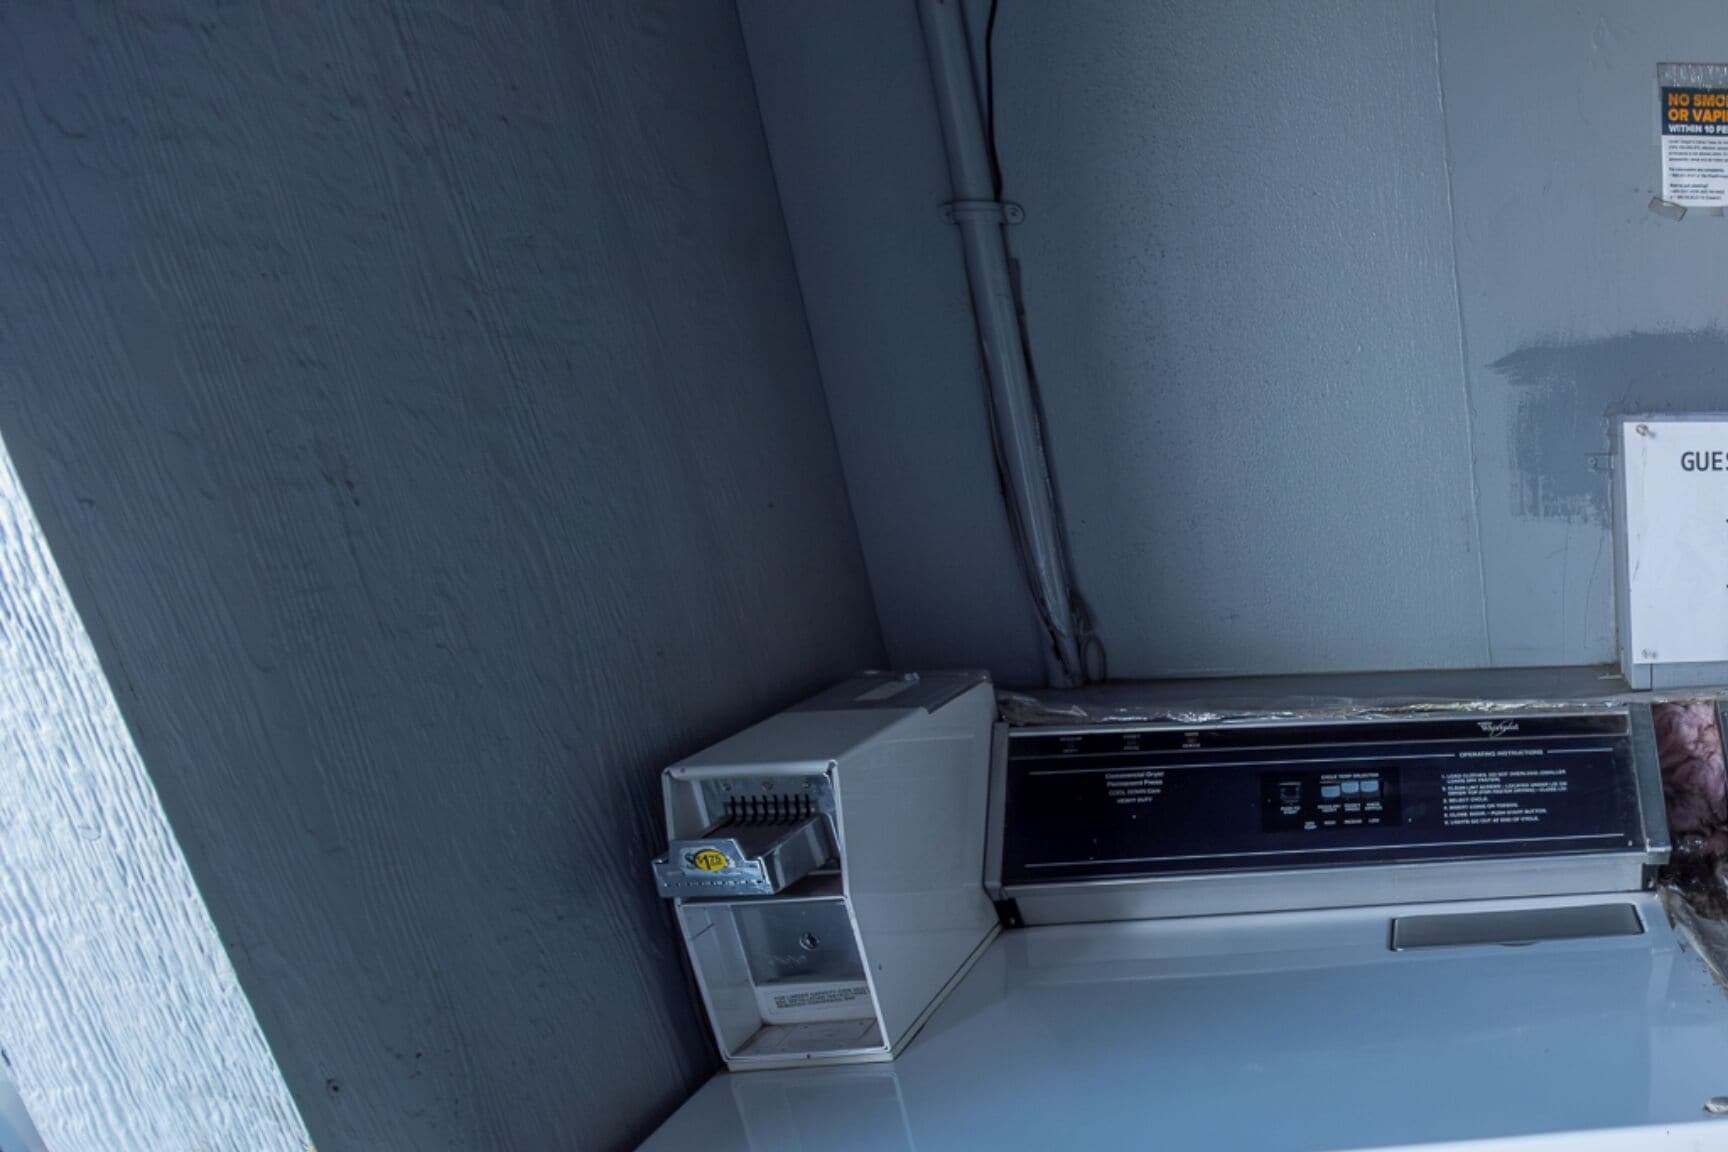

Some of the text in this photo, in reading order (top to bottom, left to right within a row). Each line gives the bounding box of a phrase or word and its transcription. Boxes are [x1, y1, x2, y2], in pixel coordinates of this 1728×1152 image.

[1668, 93, 1690, 106] NO
[1668, 108, 1689, 122] OR
[1668, 124, 1702, 133] WITHIN
[1704, 125, 1715, 134] 10
